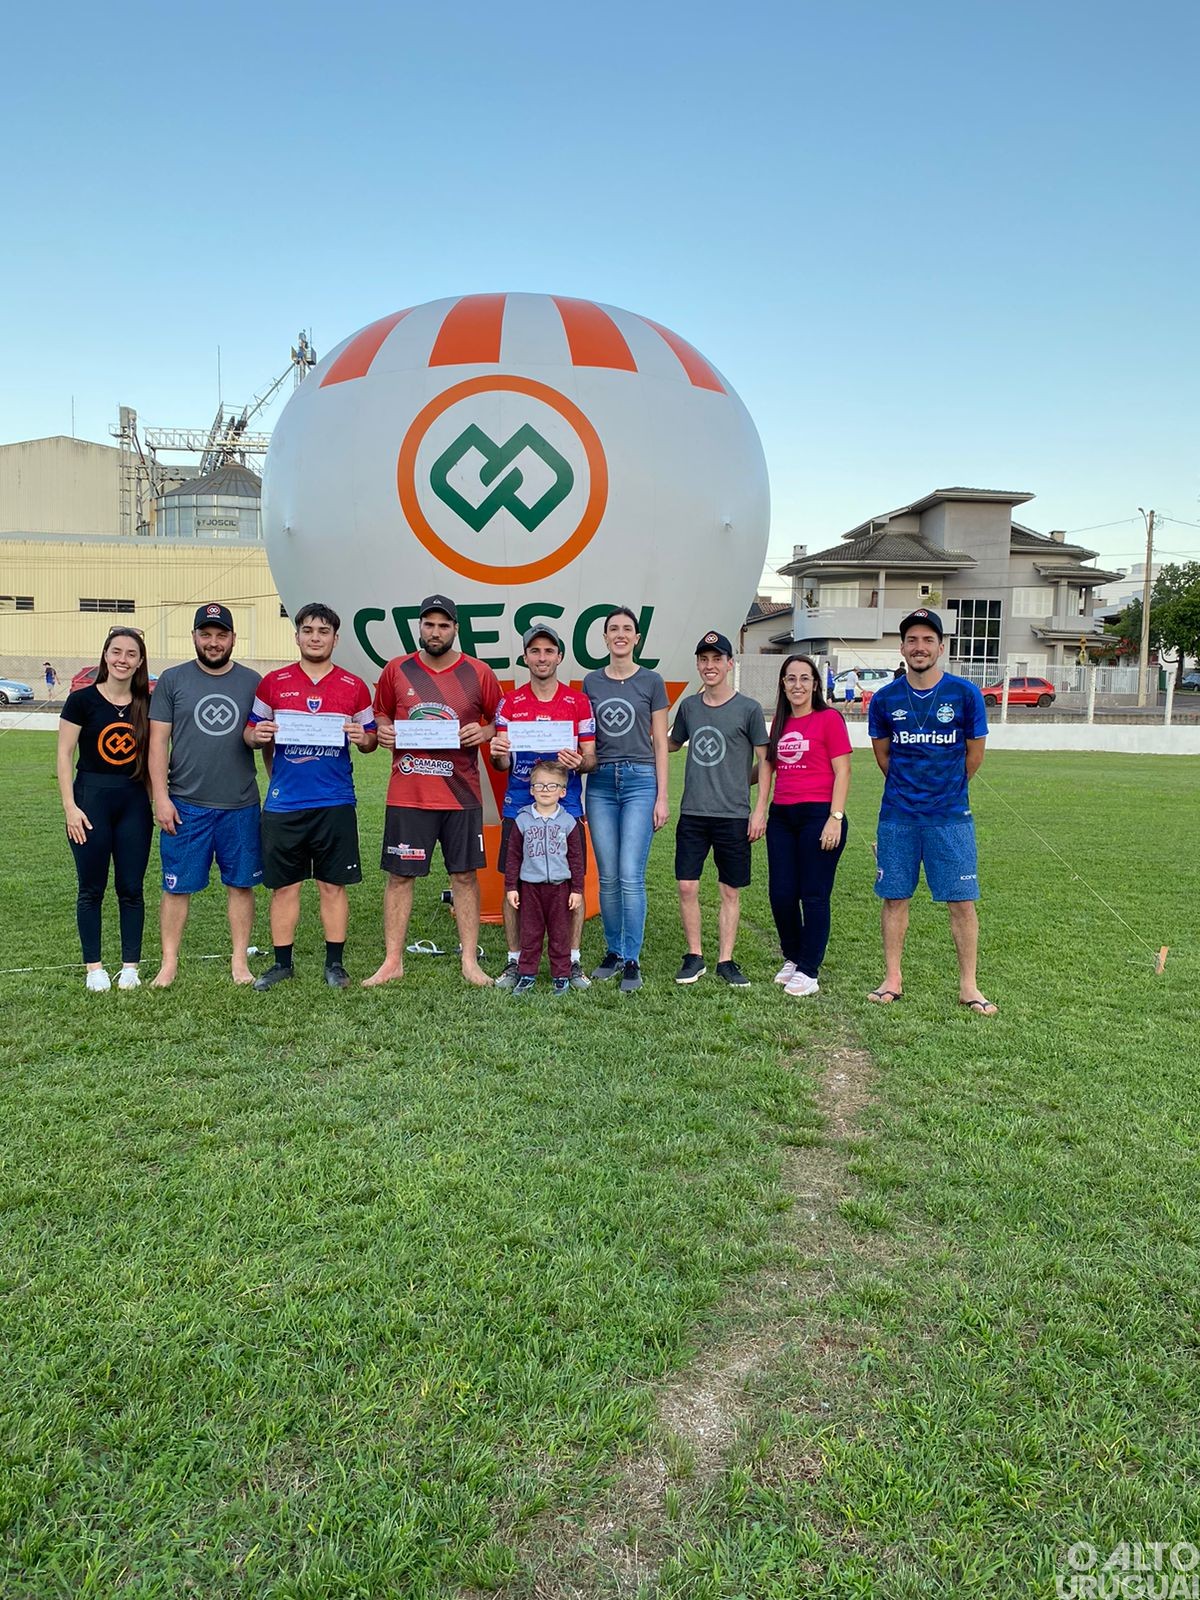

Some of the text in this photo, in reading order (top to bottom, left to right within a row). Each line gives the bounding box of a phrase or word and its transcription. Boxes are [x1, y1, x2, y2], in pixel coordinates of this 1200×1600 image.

[899, 729, 957, 745] Banrisul
[414, 758, 453, 770] CAMARGO
[526, 824, 561, 844] SPORT
